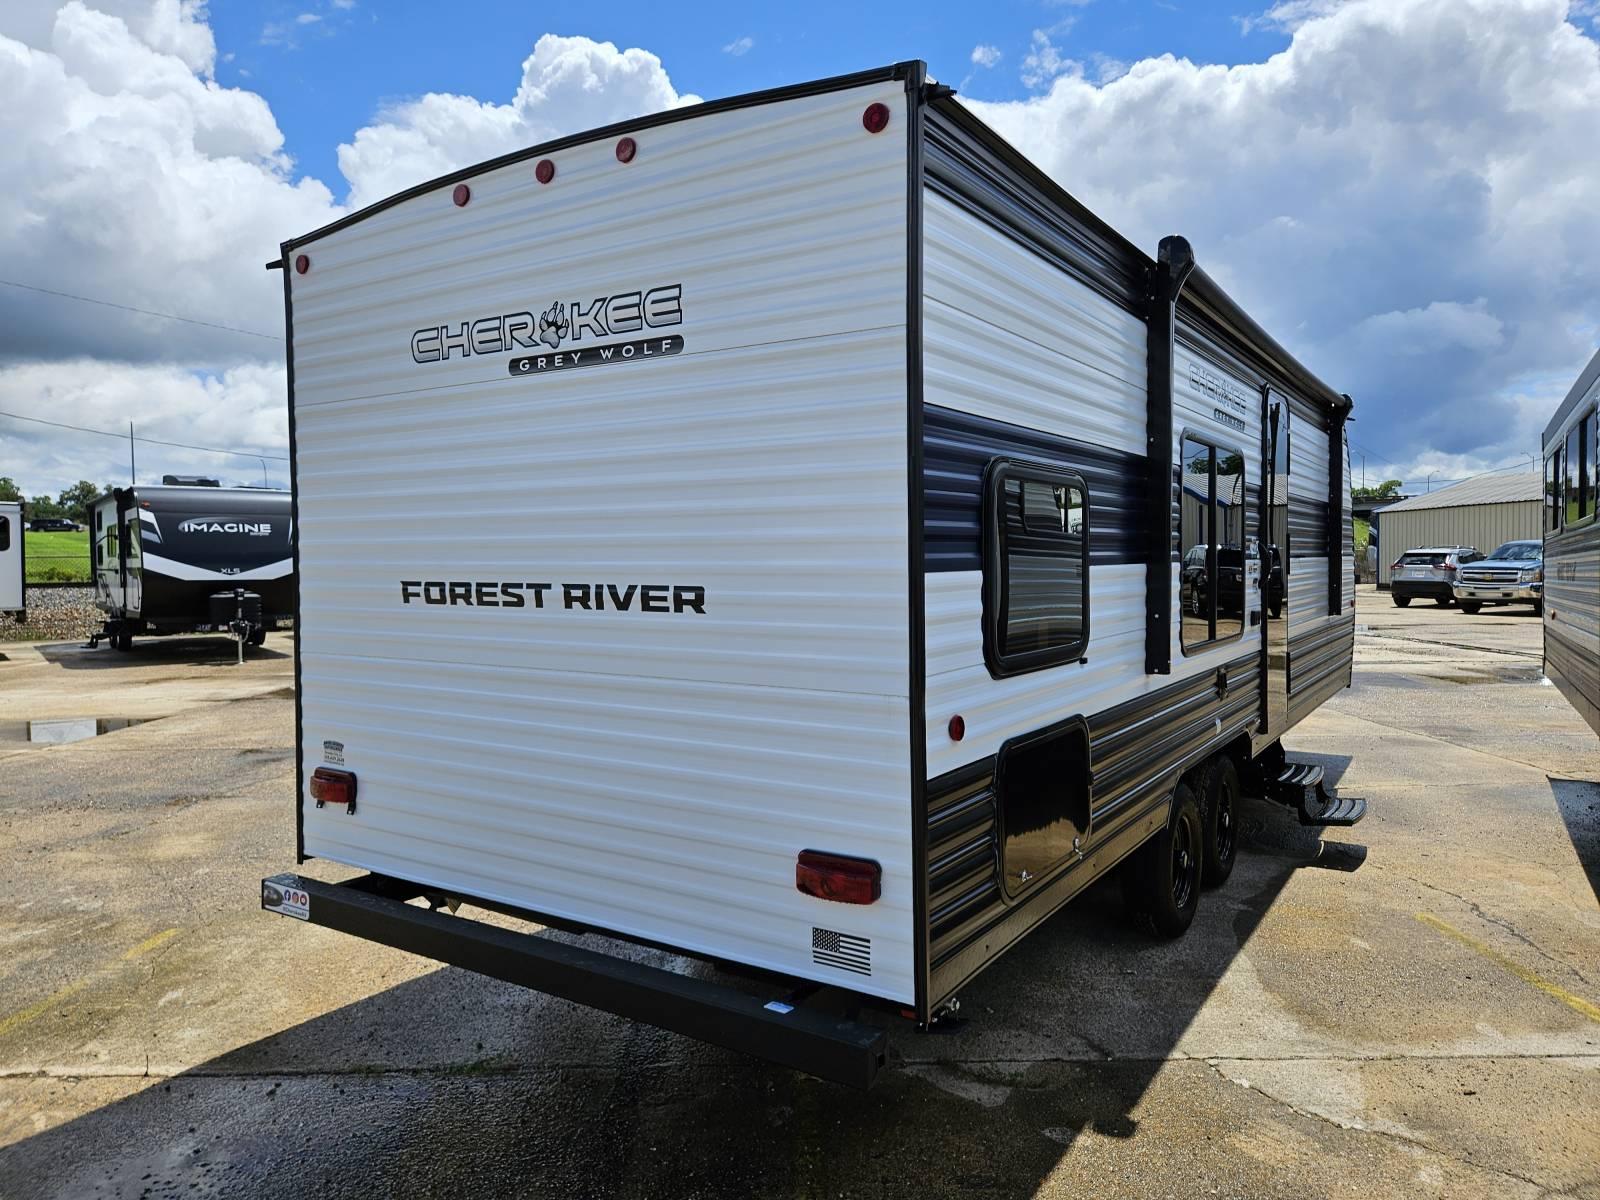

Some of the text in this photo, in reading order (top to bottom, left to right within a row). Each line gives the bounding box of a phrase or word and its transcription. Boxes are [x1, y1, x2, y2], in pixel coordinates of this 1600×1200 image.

[519, 339, 672, 372] GREY WOLF
[184, 523, 272, 533] IMAGINE
[400, 580, 707, 615] FOREST RIVER
